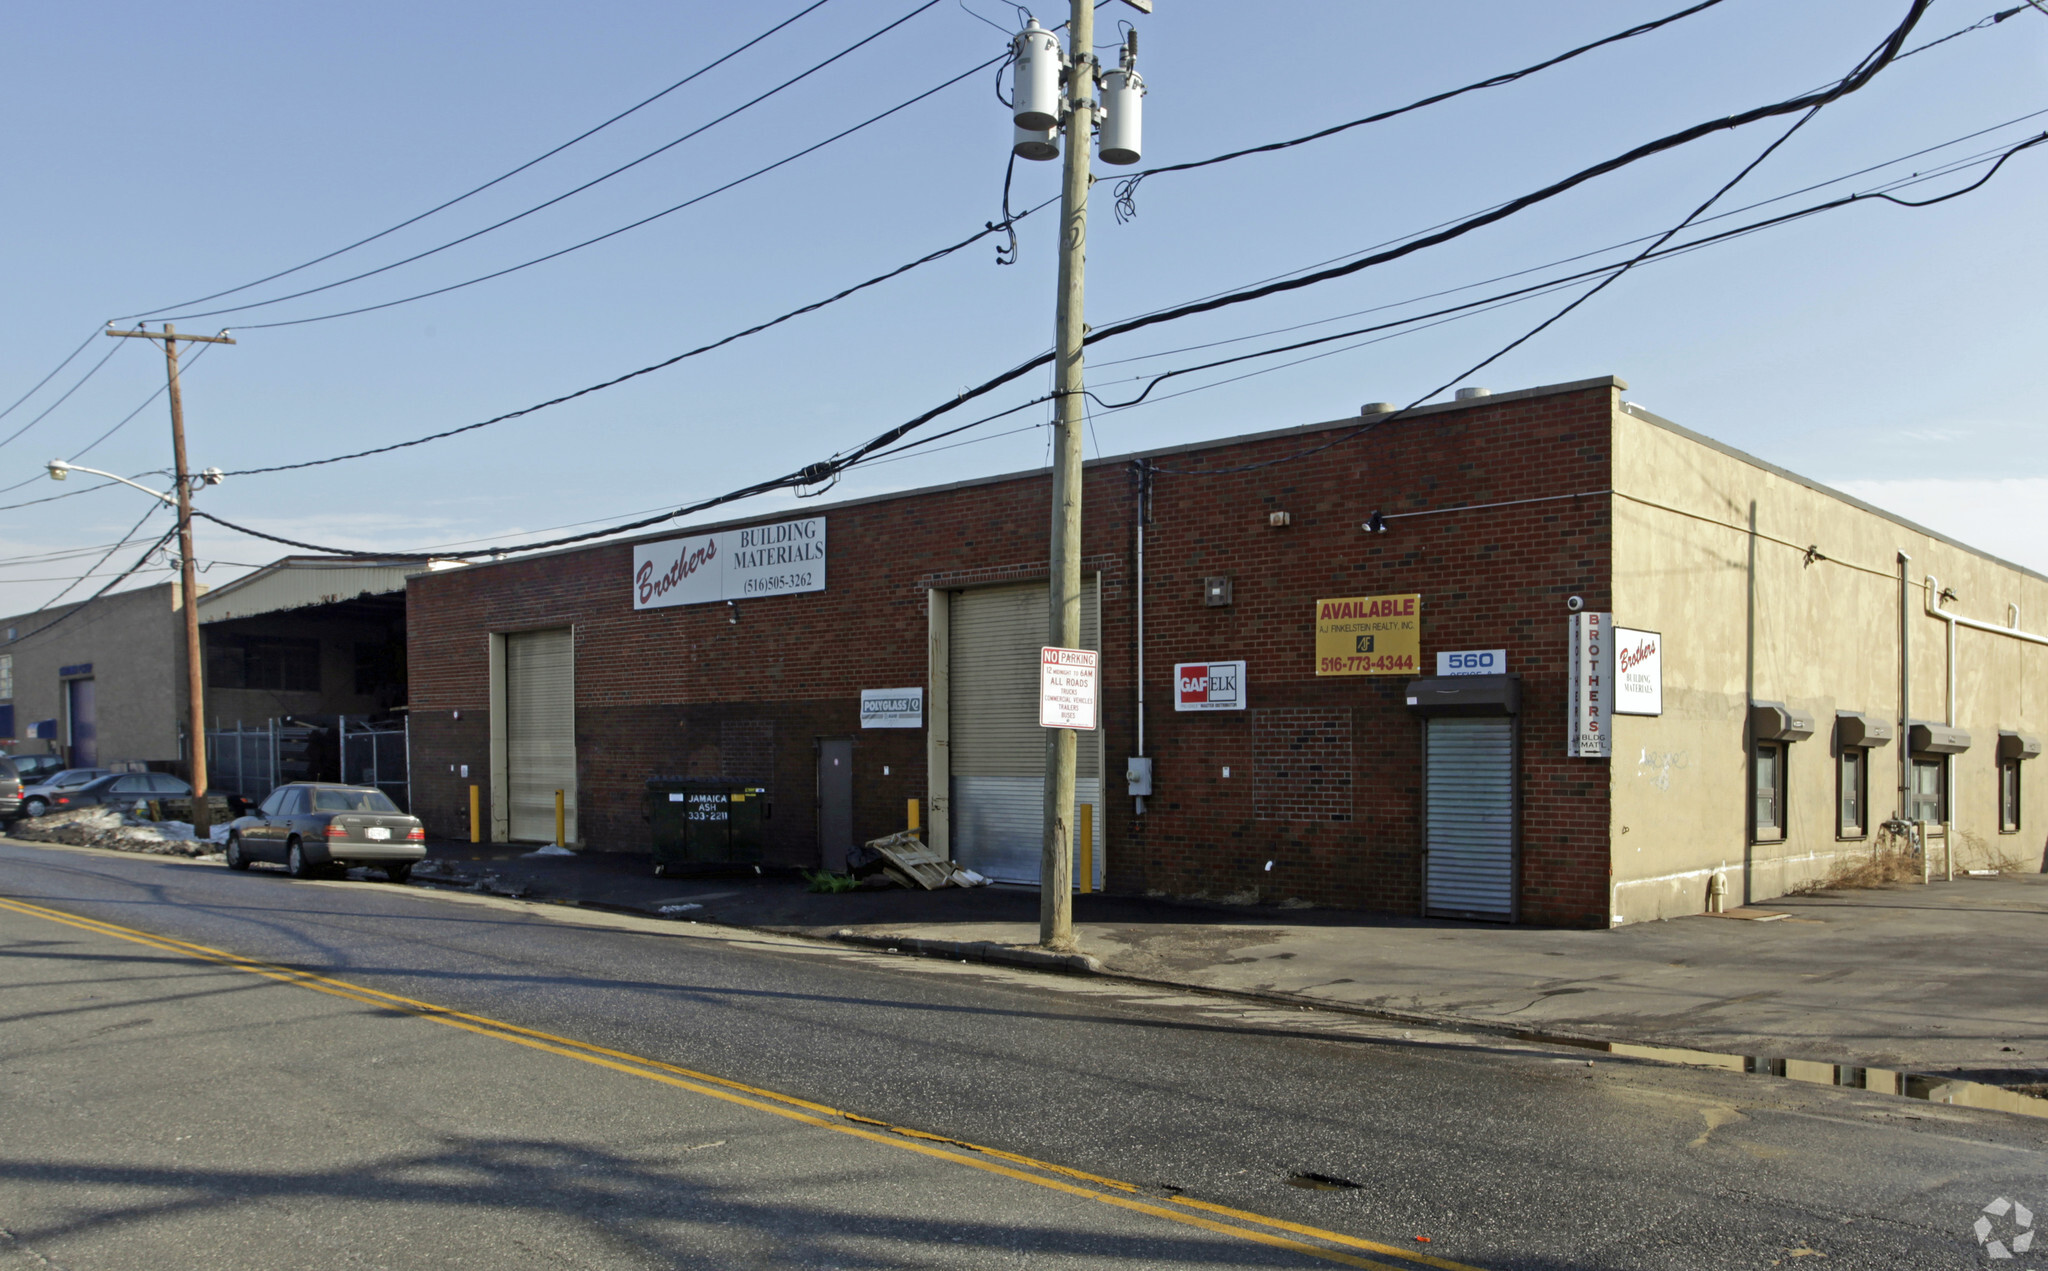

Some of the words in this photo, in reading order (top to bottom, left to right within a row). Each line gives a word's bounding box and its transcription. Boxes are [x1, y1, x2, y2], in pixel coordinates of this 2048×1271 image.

[740, 520, 816, 548] BUILDING
[734, 541, 824, 570] MATERIALS
[636, 538, 717, 605] Brothers
[744, 572, 812, 595] (516)505-3262
[1320, 599, 1415, 620] AVAILABLE
[1331, 623, 1371, 633] FINKELSTEIN
[1401, 621, 1414, 630] INC.
[1044, 650, 1058, 663] NO
[1061, 652, 1094, 665] PARKING
[1448, 653, 1494, 668] 560
[1620, 638, 1656, 673] Brothers
[1321, 655, 1414, 672] 516-773-4344
[1046, 666, 1052, 674] 12
[1080, 670, 1092, 678] 6AM
[1588, 614, 1600, 732] BROTHERS
[1626, 673, 1651, 683] BUILDING
[1050, 677, 1062, 686] ALL
[1066, 678, 1089, 688] ROADS
[1181, 676, 1208, 692] GAF
[1210, 676, 1236, 691] ELK
[1624, 683, 1653, 694] MATERIALS
[864, 700, 908, 711] POLYGLASS
[1045, 694, 1071, 703] COMMERCIAL
[688, 795, 728, 803] JAMAICA
[688, 811, 728, 820] 333-2211
